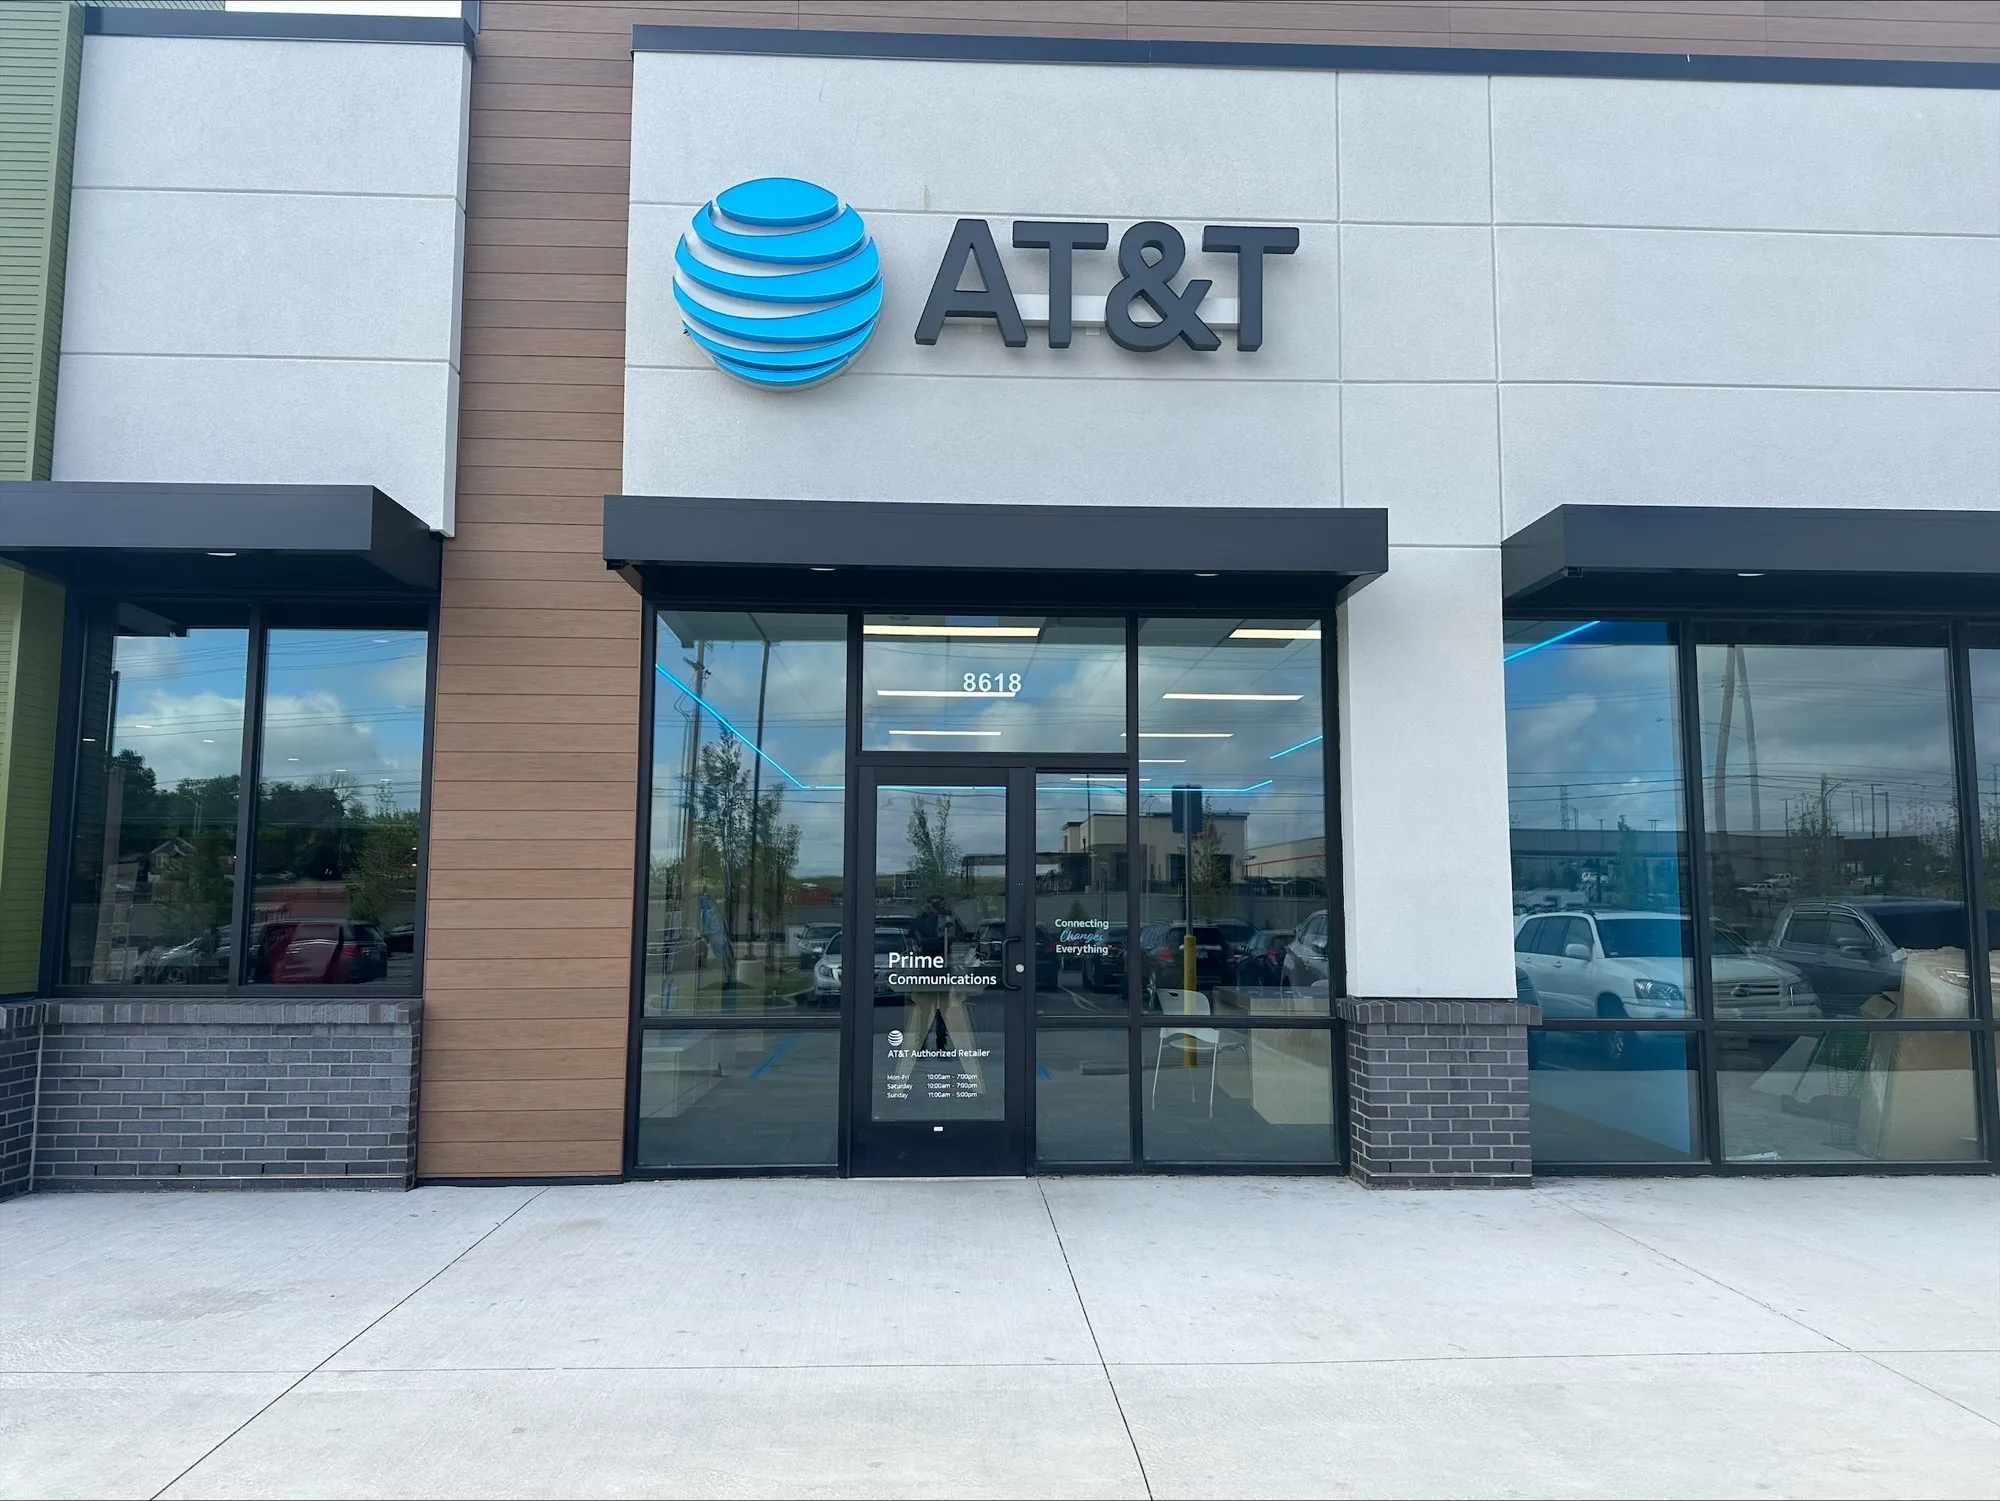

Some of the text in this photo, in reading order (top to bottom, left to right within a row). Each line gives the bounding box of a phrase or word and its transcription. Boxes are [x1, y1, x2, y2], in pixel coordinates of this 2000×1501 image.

[914, 218, 1300, 352] AT&T
[963, 672, 1022, 693] 8618
[1054, 918, 1109, 930] Connecting
[1060, 930, 1104, 943] Changes
[888, 951, 944, 969] Prime
[888, 973, 997, 985] Communications
[887, 1049, 991, 1058] AT&T Authorized Retailer
[956, 1073, 978, 1081] 7:00pm
[886, 1083, 913, 1091] Saturday
[956, 1082, 978, 1090] 7:00pm
[886, 1092, 909, 1100] Sunday
[956, 1091, 978, 1099] 5:00pm
